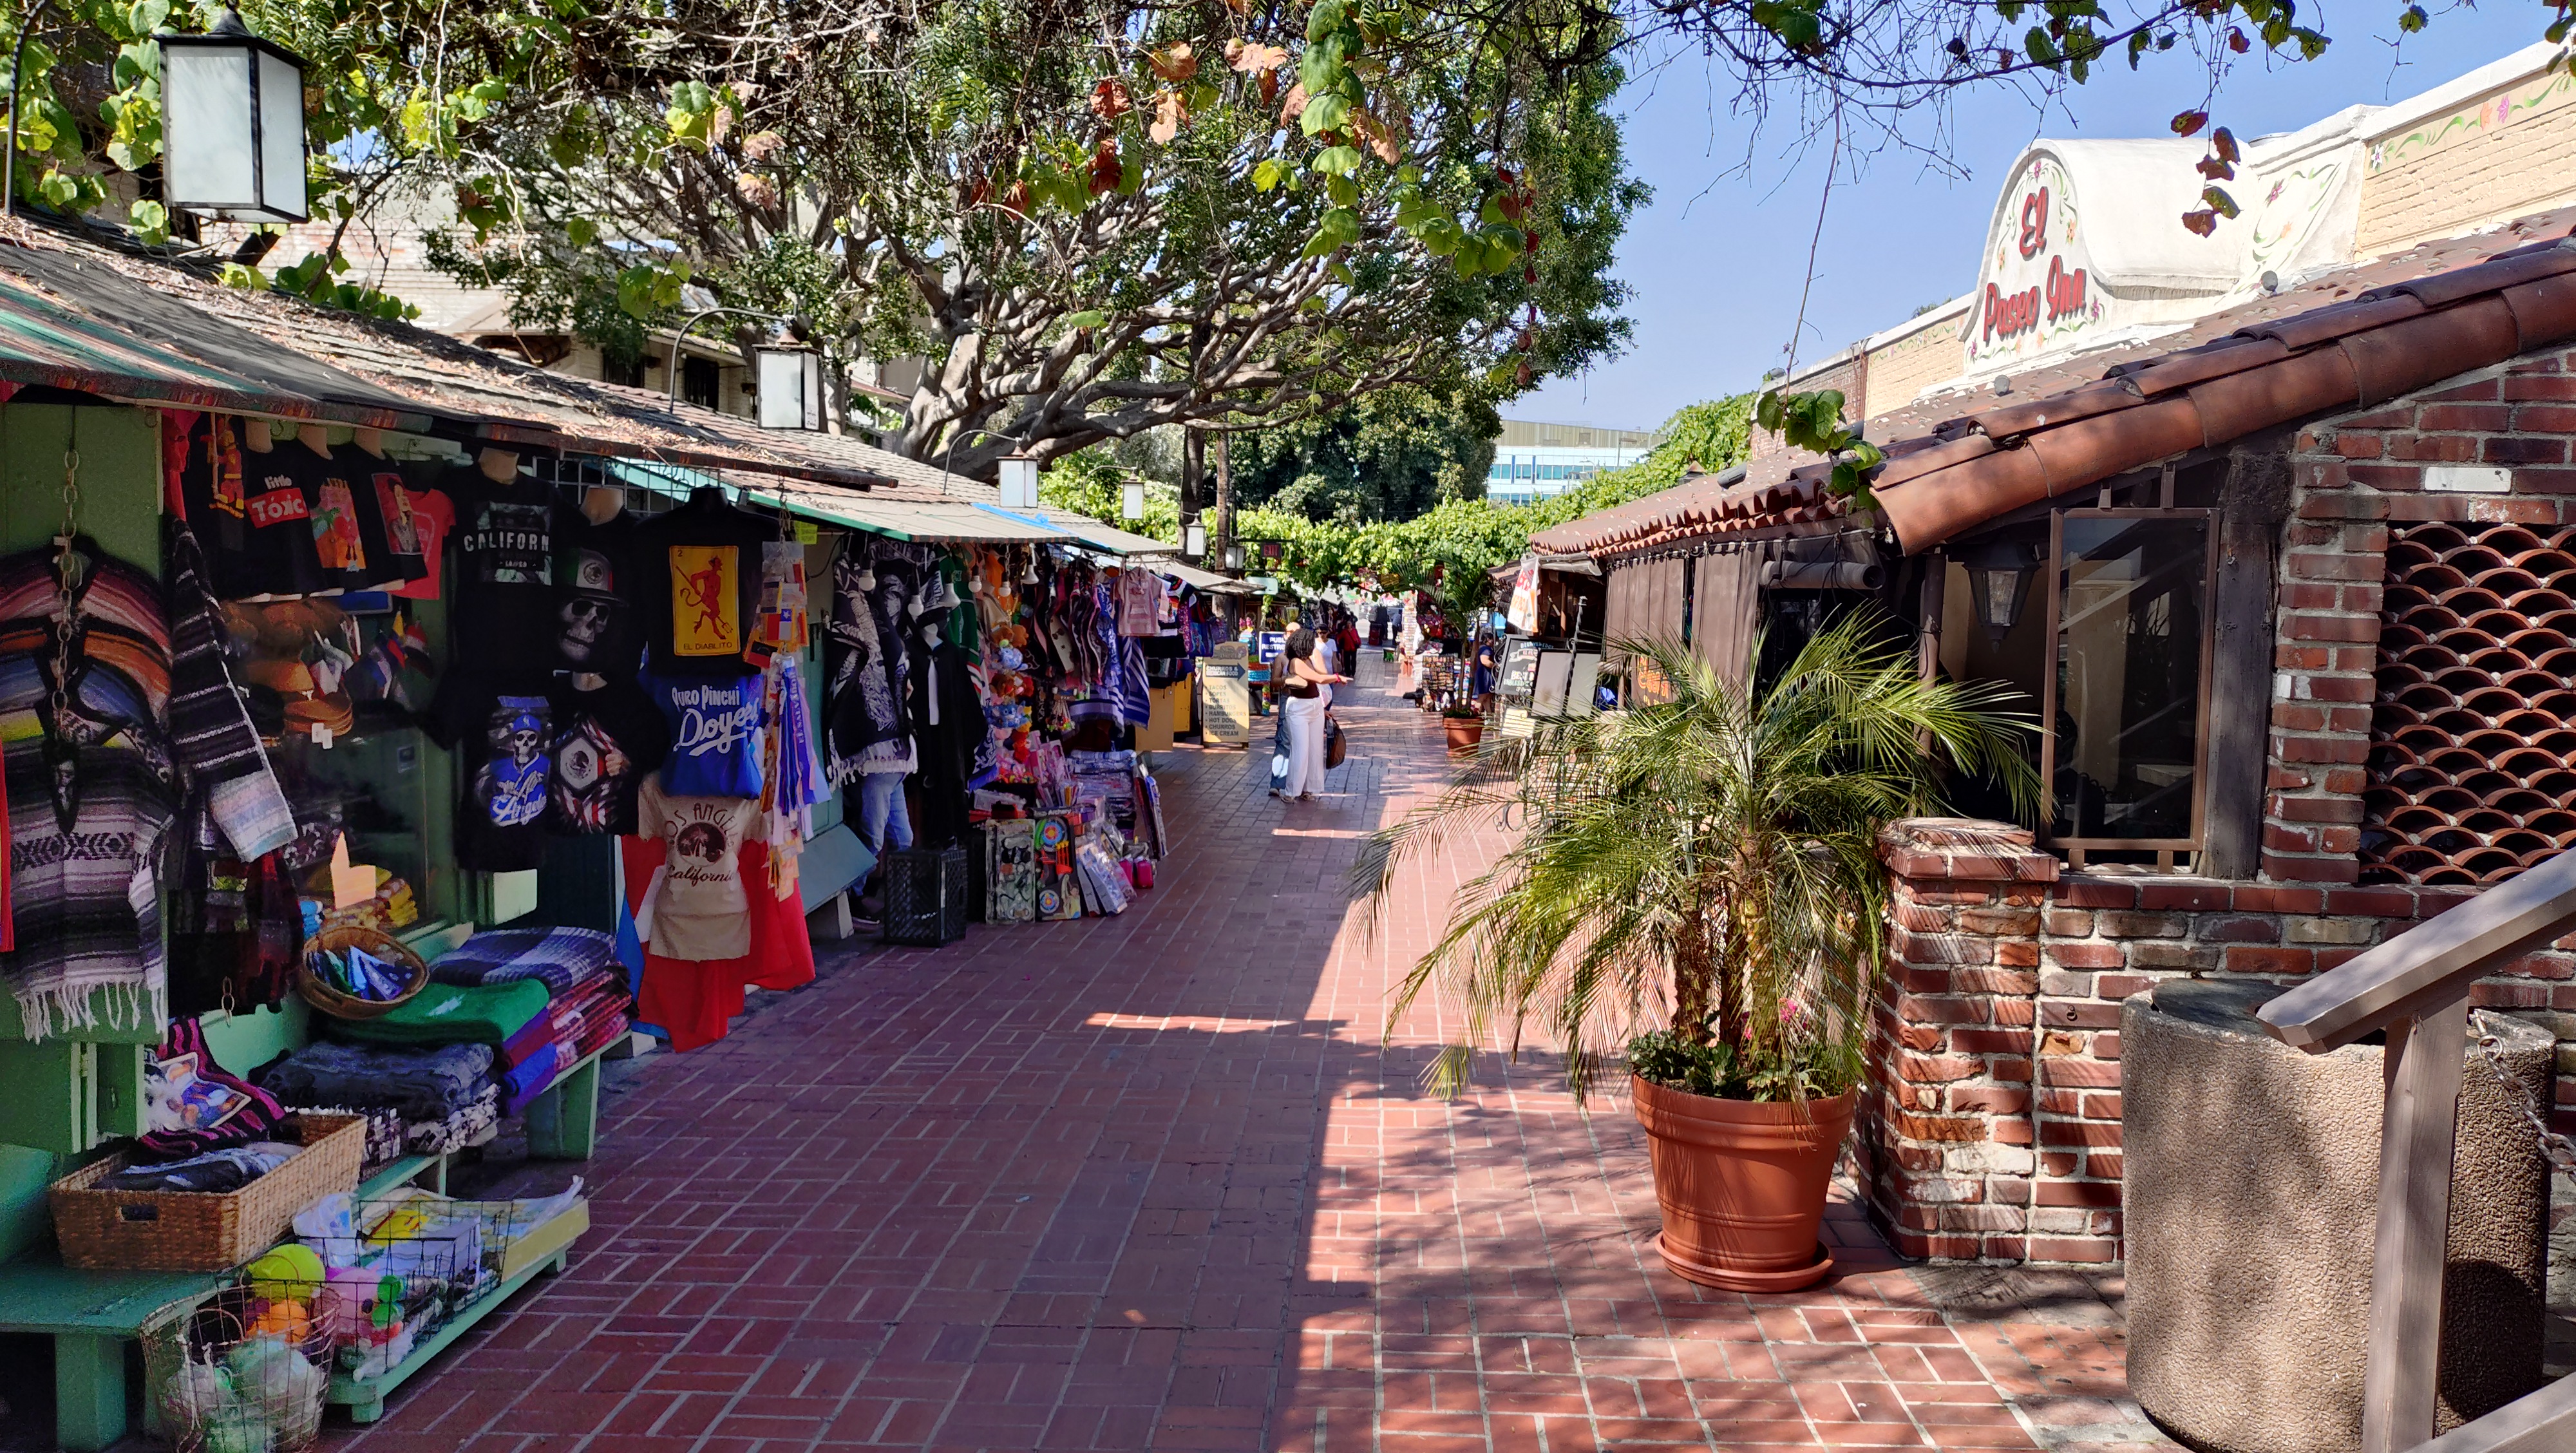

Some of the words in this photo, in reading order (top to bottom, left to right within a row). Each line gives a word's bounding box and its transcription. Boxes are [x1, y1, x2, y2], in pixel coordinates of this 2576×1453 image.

[2020, 186, 2049, 257] El
[1983, 282, 2041, 343] Paseo
[2046, 255, 2087, 321] Inn
[1264, 545, 1278, 556] EXIT
[695, 641, 734, 651] DIABLITO
[672, 687, 700, 712] PURO
[701, 685, 740, 711] PINCHI
